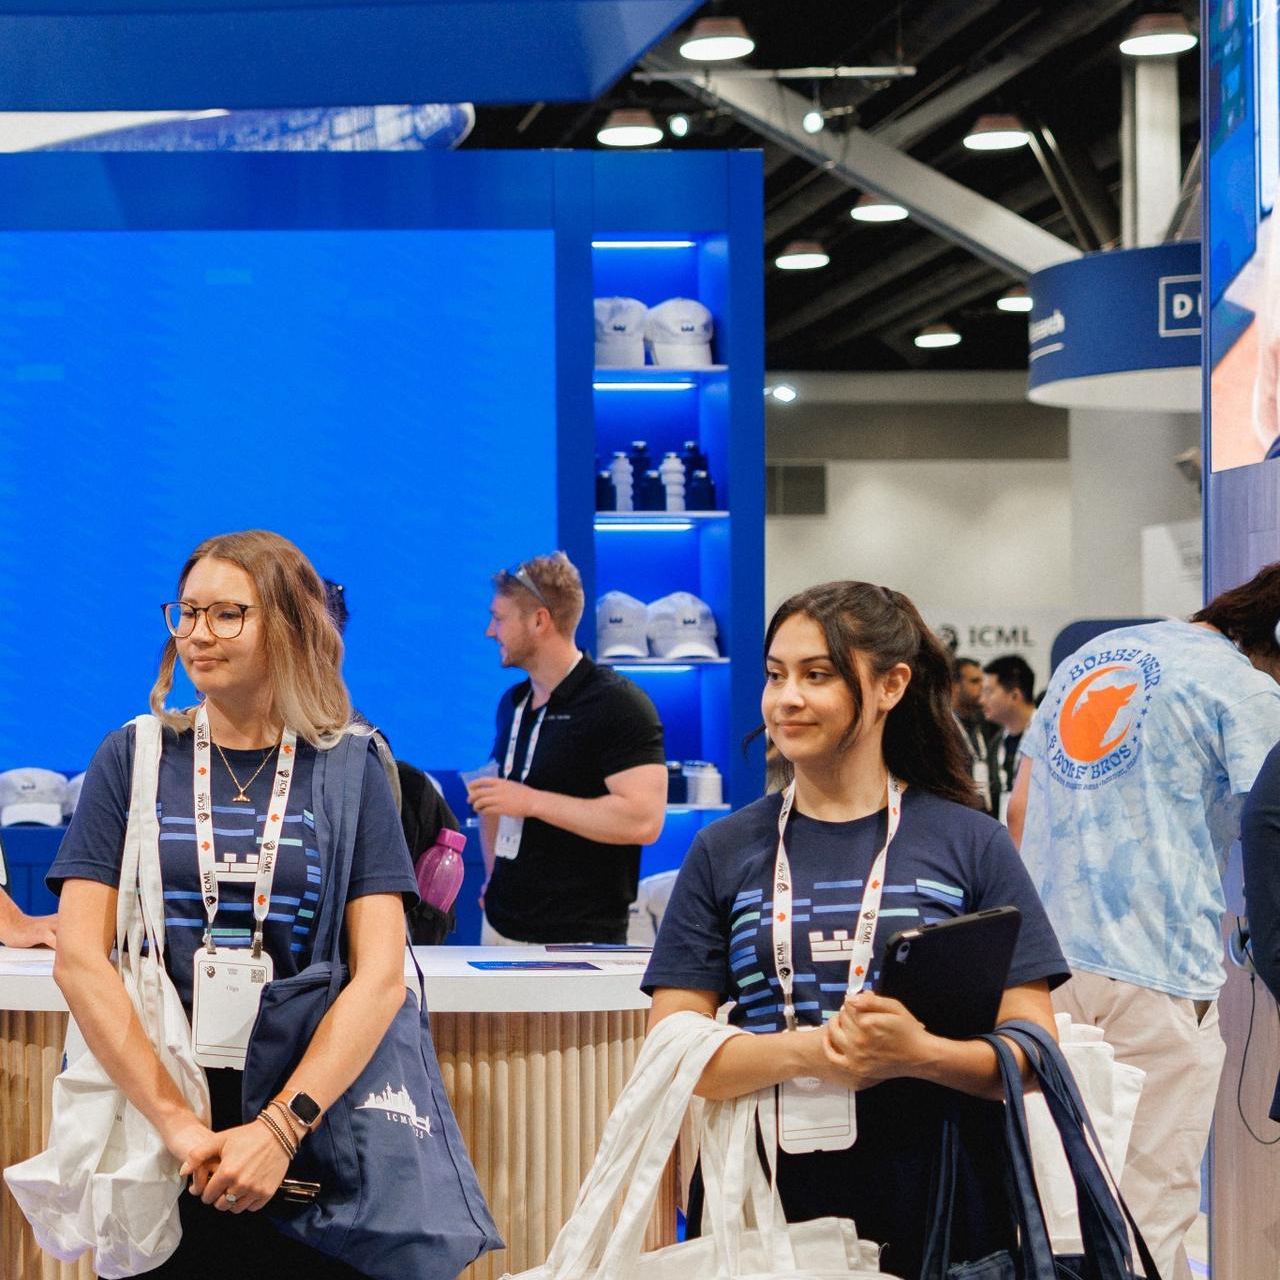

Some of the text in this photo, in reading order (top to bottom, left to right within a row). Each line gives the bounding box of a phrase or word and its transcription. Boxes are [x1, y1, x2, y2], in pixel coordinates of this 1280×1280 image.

[1172, 293, 1202, 320] D
[967, 625, 1035, 648] ICML
[1069, 648, 1143, 682] BOBBY
[197, 723, 205, 741] ICML
[1051, 748, 1088, 780] WOLF
[1090, 744, 1133, 780] BROS
[278, 779, 288, 798] ICML
[197, 792, 205, 811] ICML
[263, 852, 274, 874] ICML
[777, 861, 785, 881] ICML
[204, 870, 213, 893] ICML
[863, 922, 873, 945] ICML
[777, 940, 785, 966] ICML
